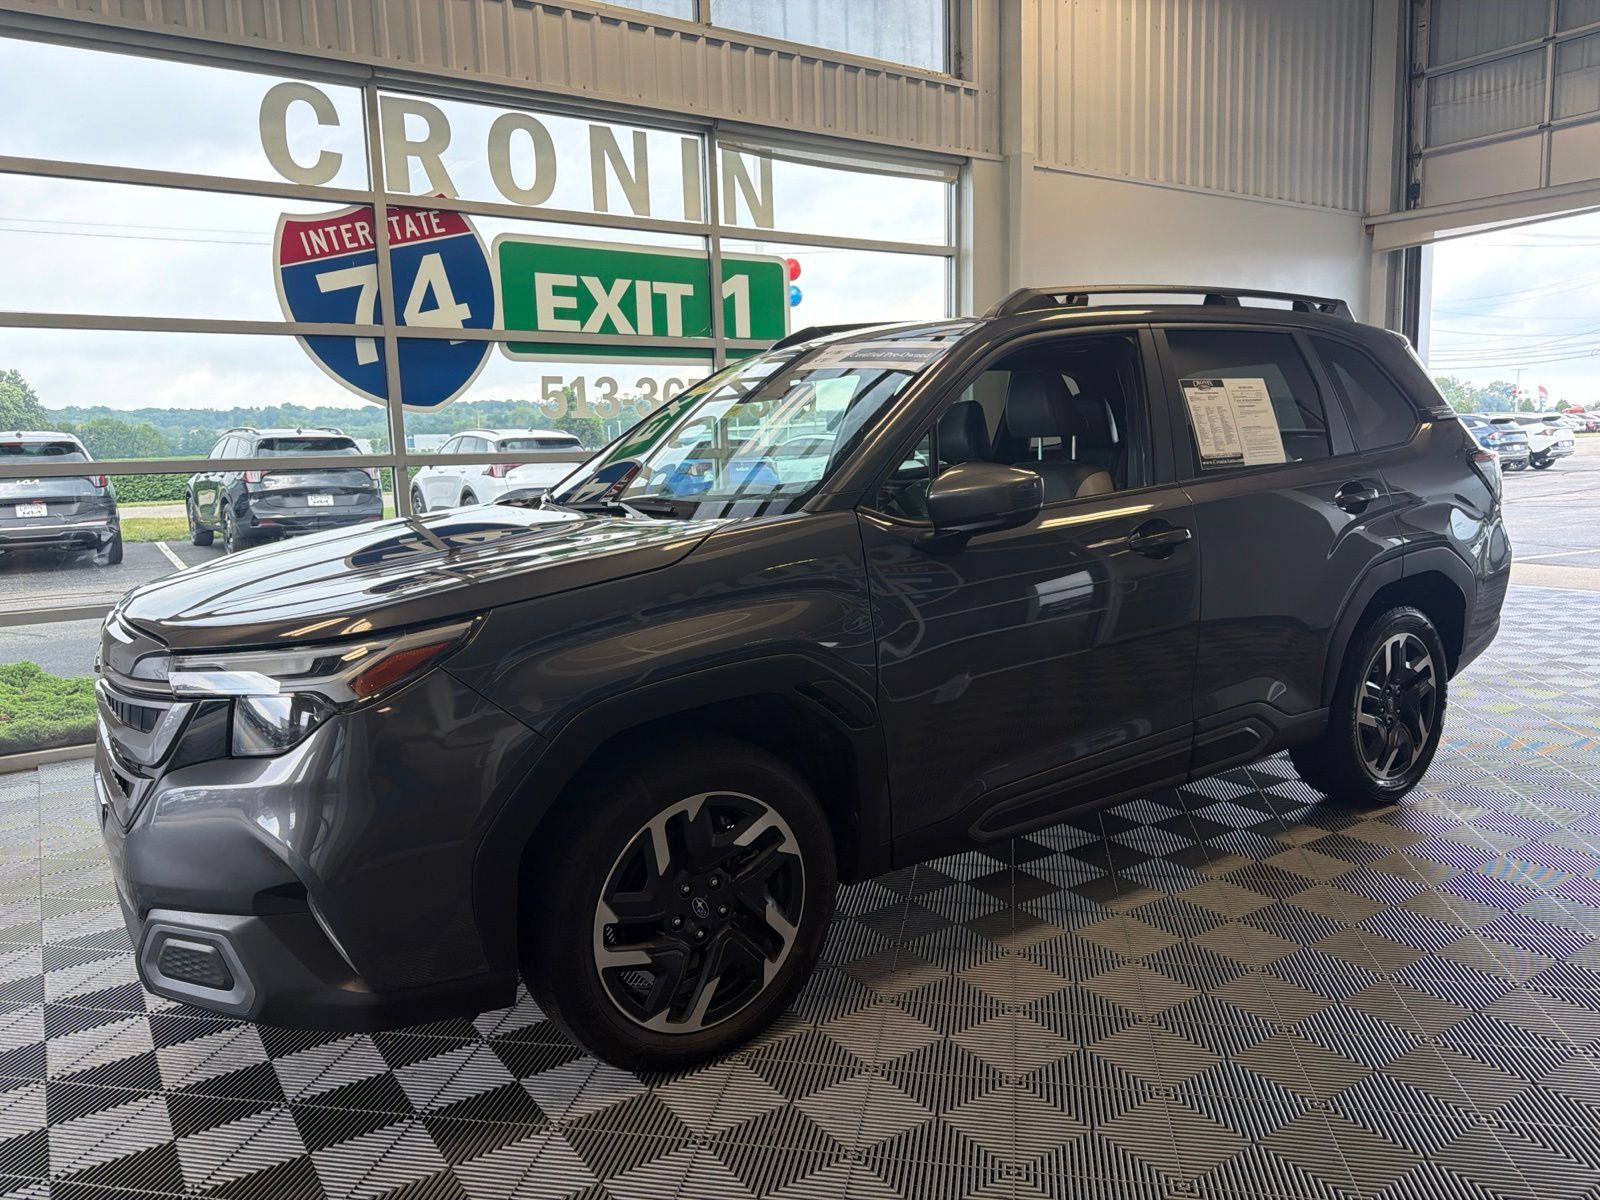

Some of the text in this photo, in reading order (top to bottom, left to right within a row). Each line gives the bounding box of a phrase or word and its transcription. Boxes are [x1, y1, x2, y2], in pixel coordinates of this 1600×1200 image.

[259, 82, 775, 229] CRONIN
[300, 211, 446, 256] INTERTATE
[315, 253, 473, 366] 74
[534, 272, 751, 338] EXIT 1
